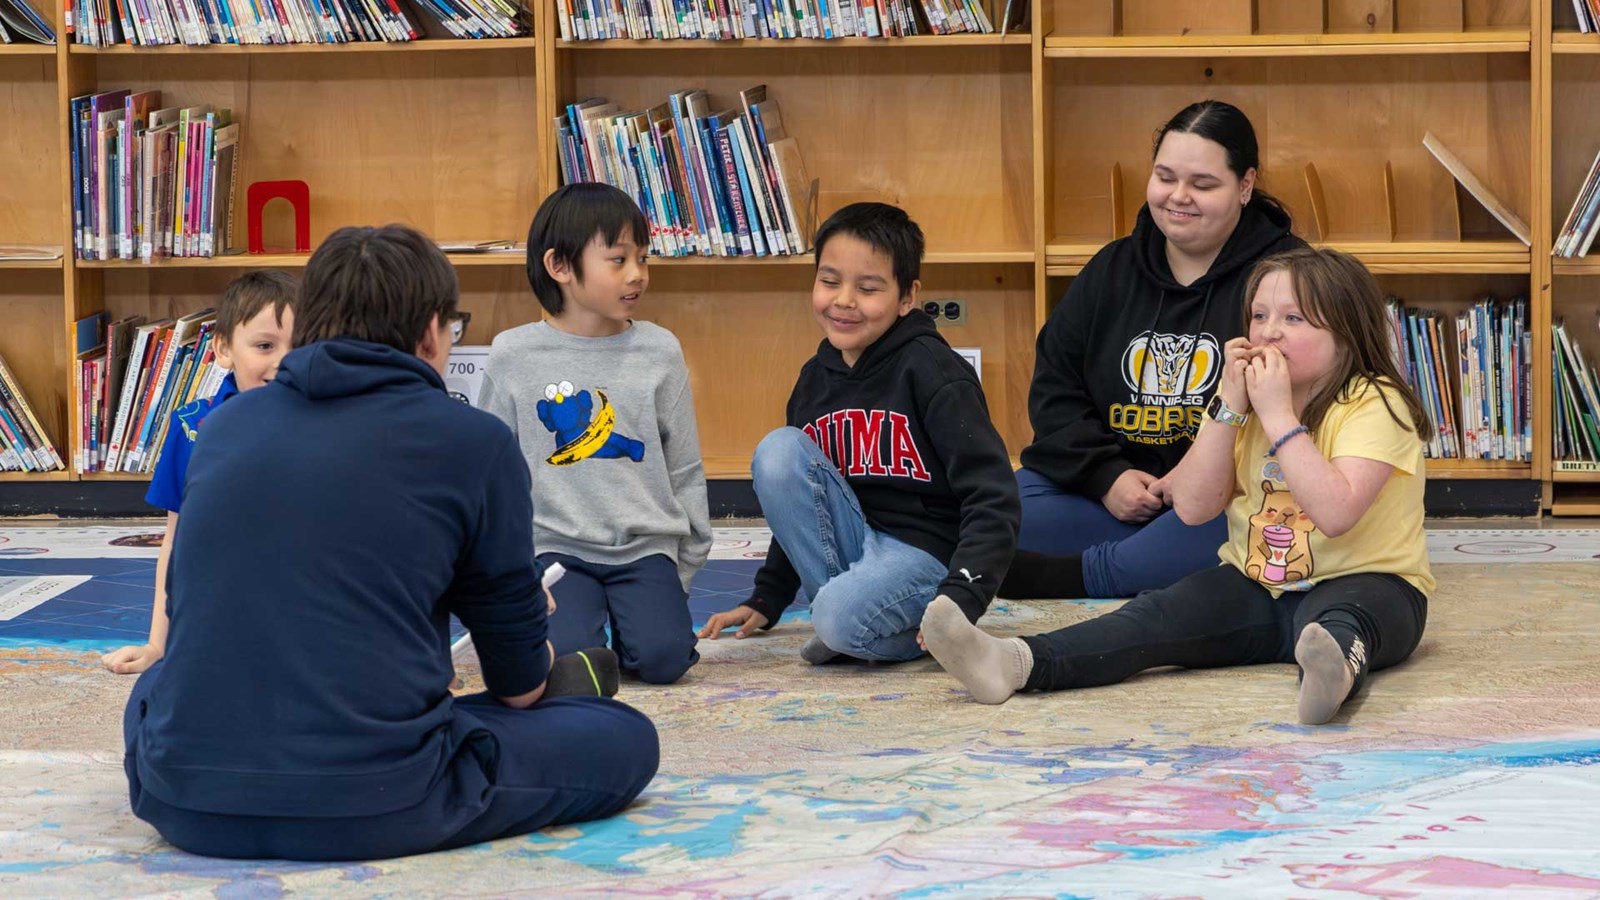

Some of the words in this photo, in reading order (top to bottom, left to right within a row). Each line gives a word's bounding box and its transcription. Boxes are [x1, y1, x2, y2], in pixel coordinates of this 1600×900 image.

[449, 362, 475, 375] 700
[1130, 393, 1204, 406] WINNIPEG
[1109, 403, 1206, 436] COBRA
[1127, 431, 1198, 445] BASKETBAL
